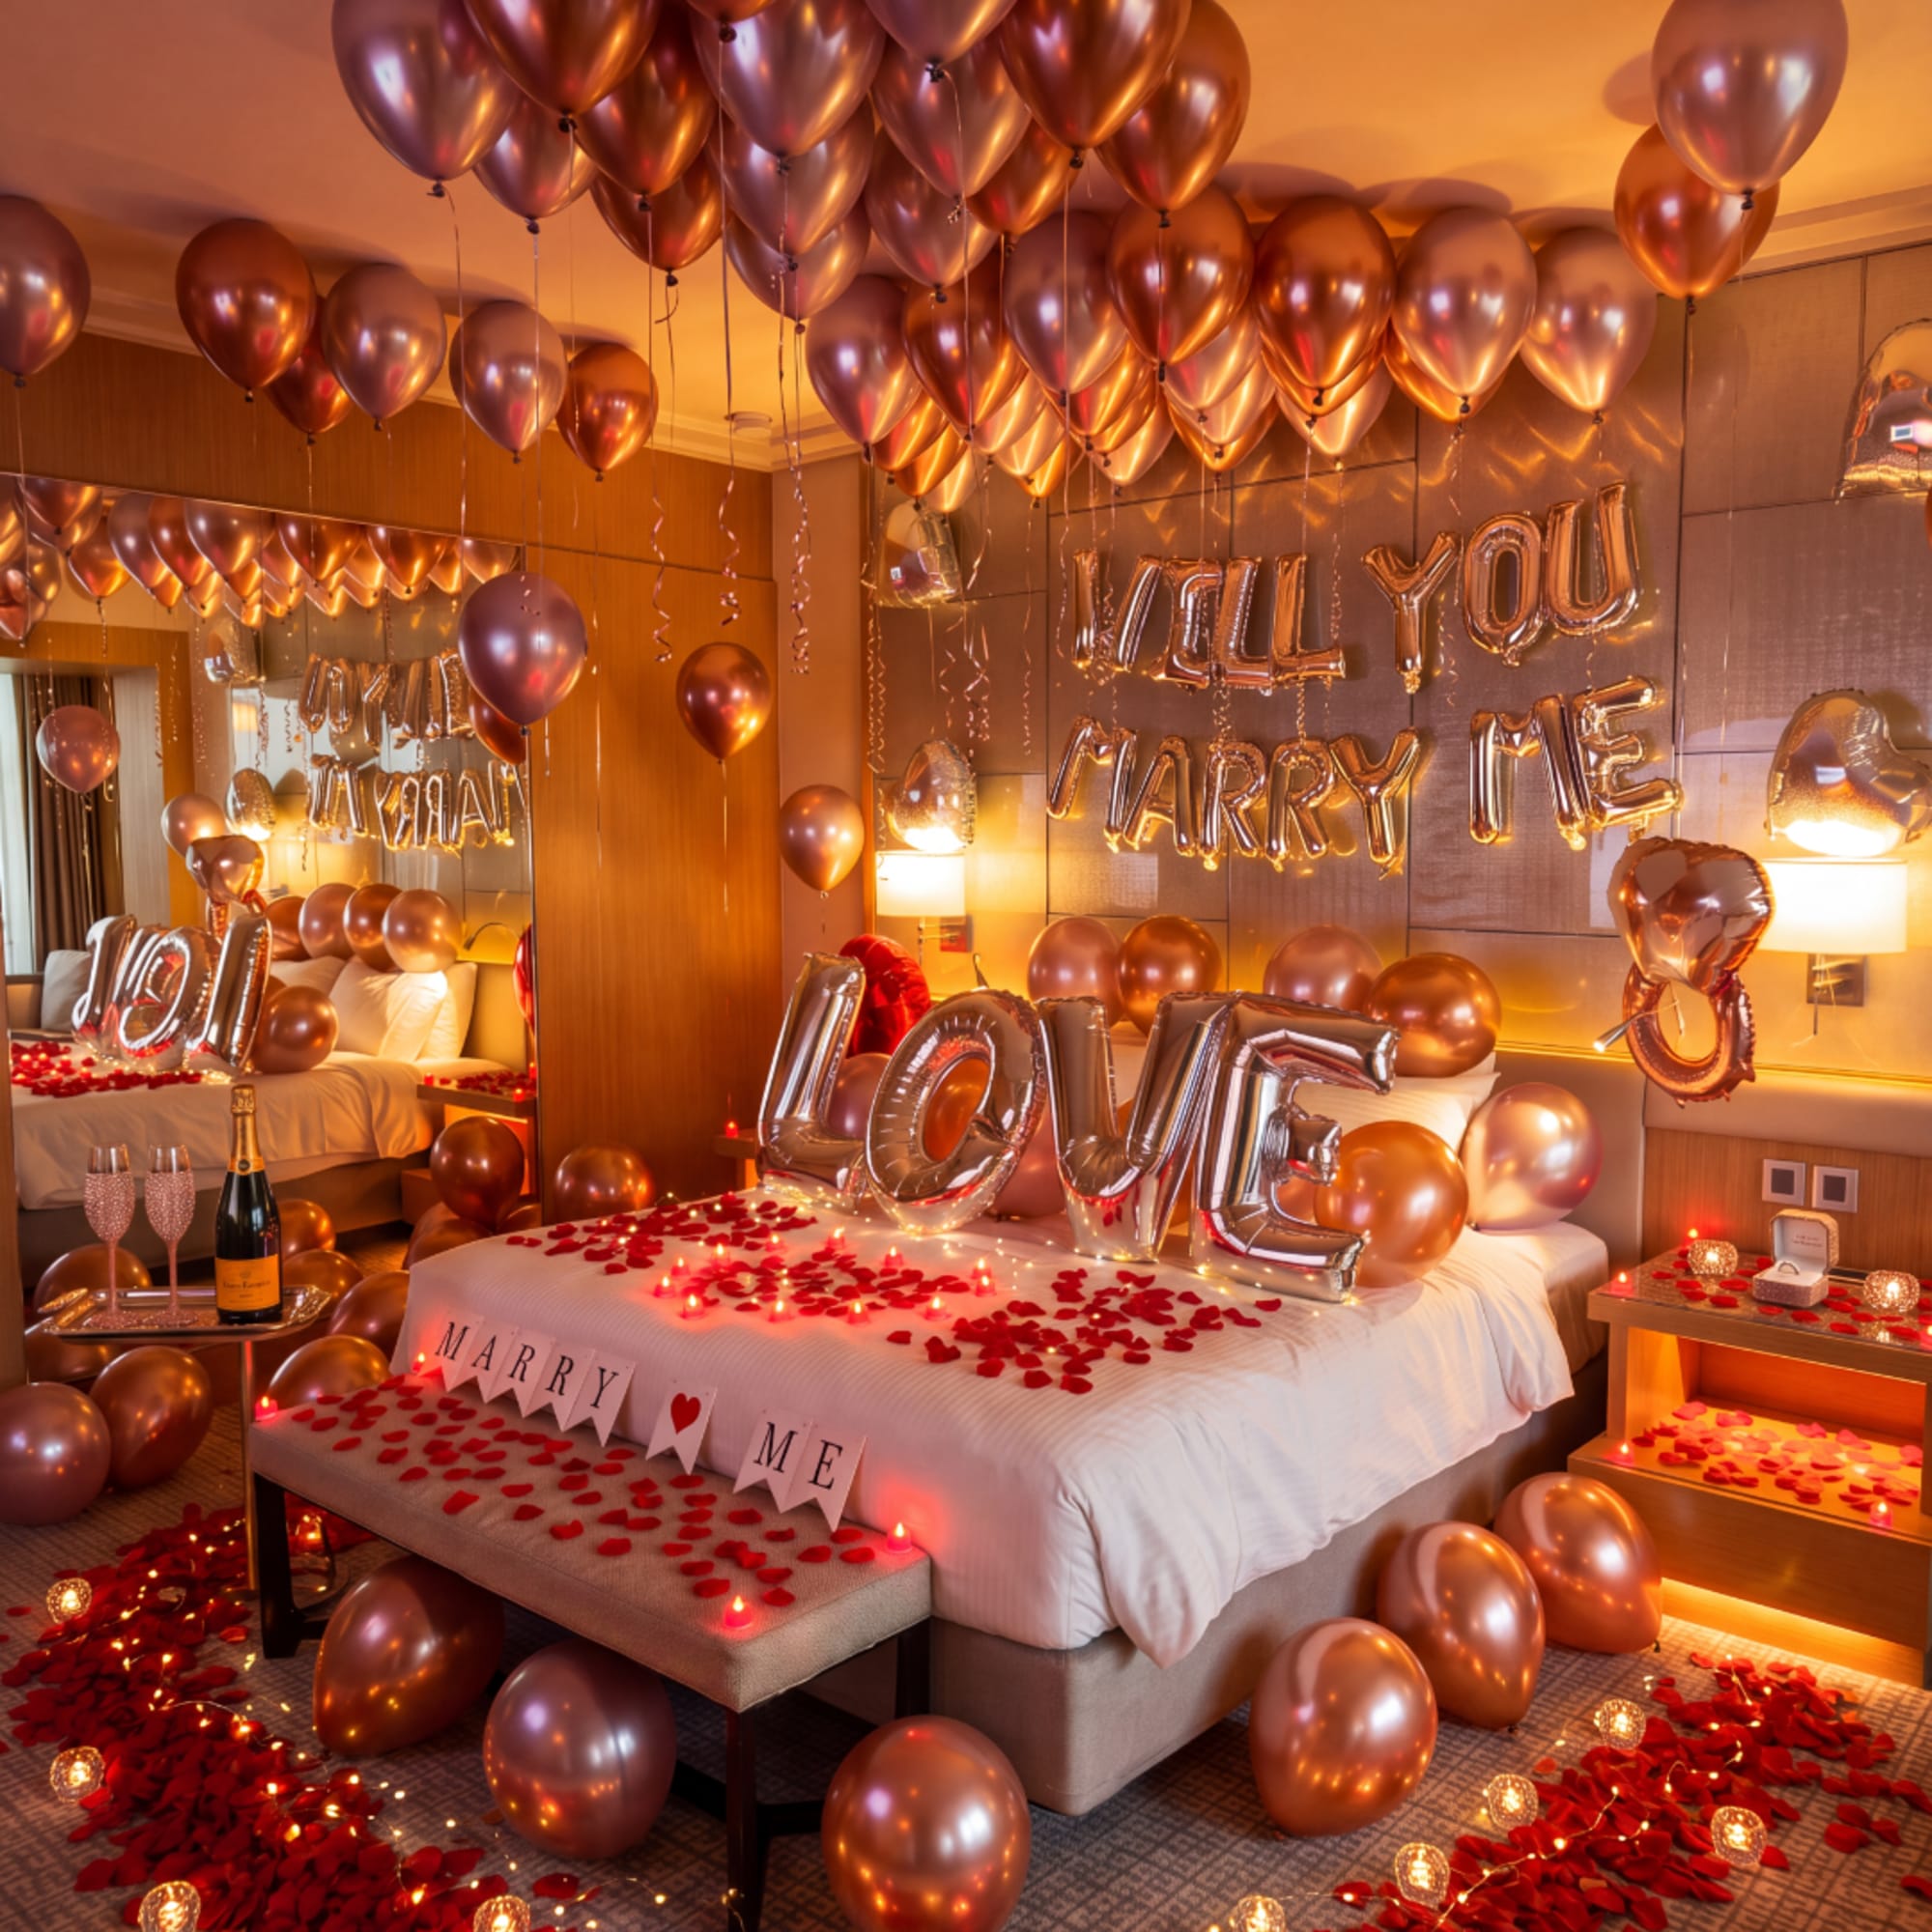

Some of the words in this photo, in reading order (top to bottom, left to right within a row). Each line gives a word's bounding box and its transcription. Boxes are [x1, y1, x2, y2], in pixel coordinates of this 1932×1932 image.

[1361, 480, 1642, 694] YOU
[1046, 714, 1422, 875] MARRY
[1469, 674, 1685, 852] ME
[757, 952, 1402, 1303] LOVE
[434, 1321, 620, 1410] MARRY
[753, 1421, 844, 1491] ME
